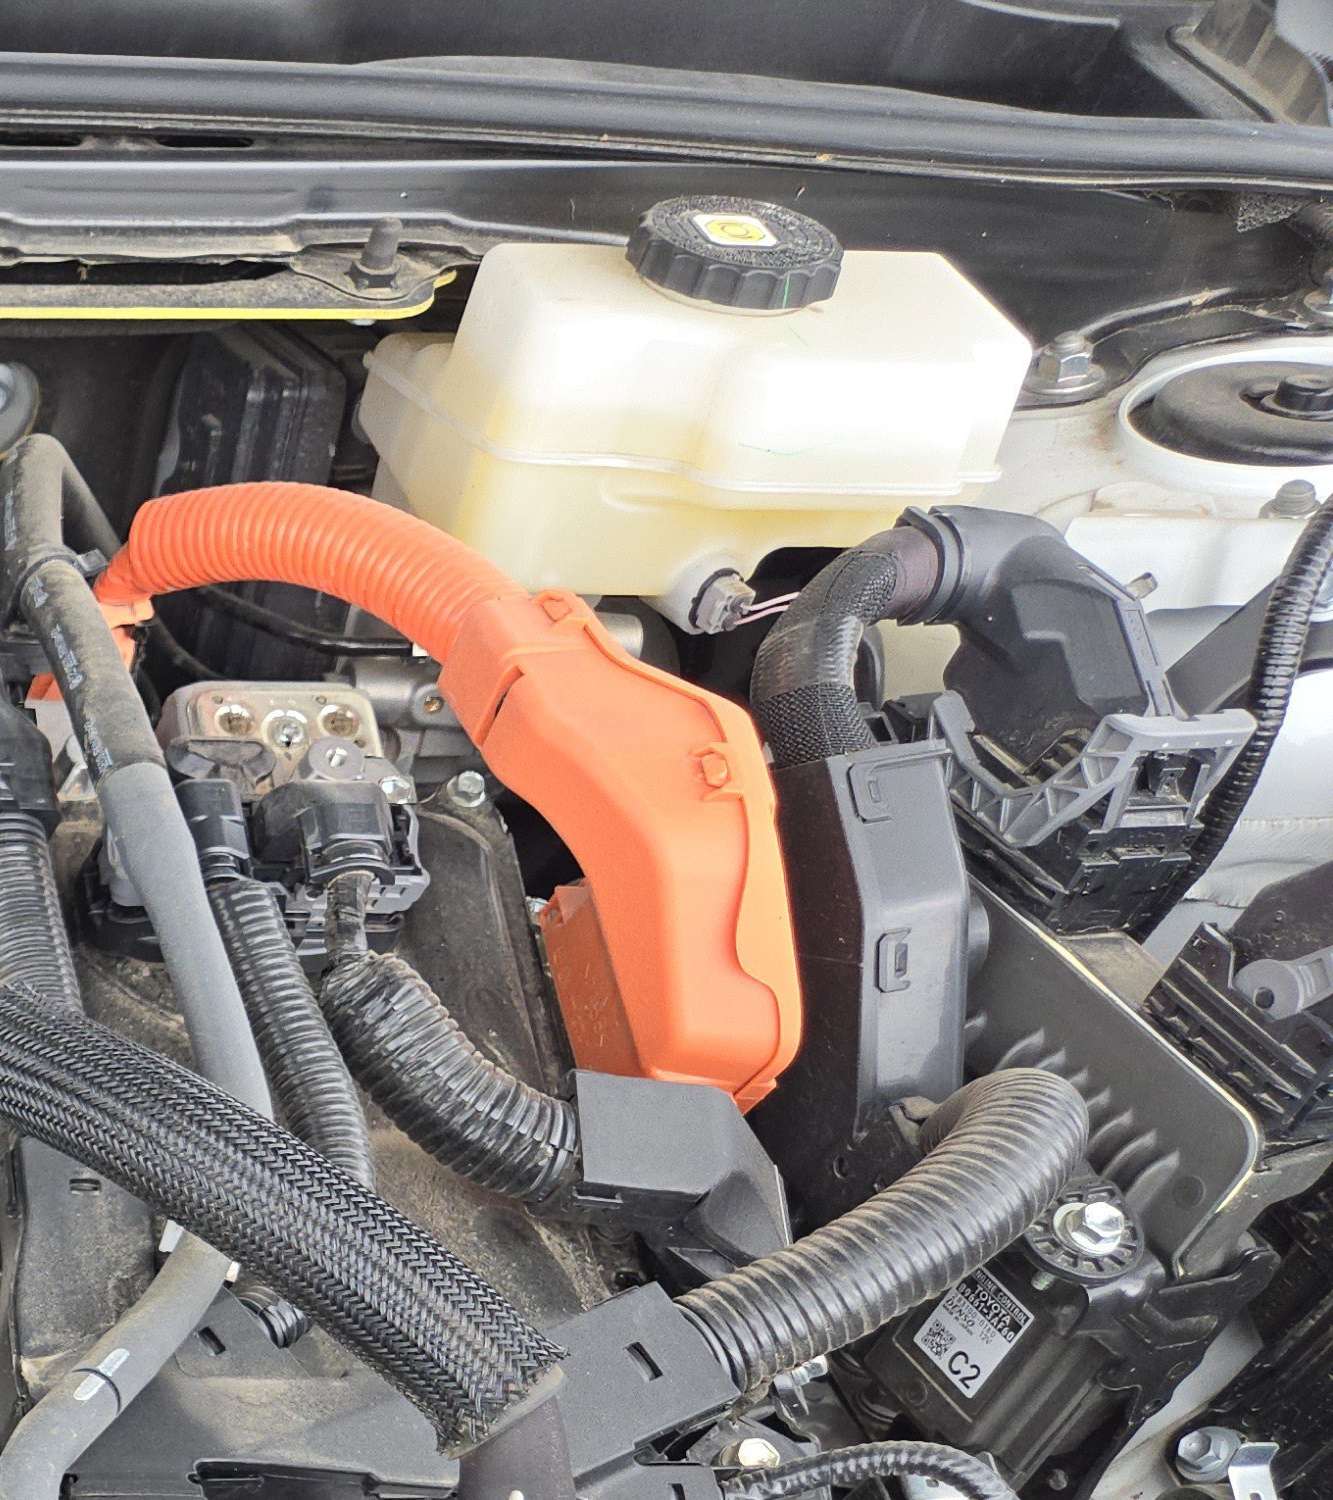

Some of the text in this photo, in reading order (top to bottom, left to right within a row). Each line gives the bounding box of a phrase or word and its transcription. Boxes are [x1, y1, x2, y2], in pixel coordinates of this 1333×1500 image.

[971, 1284, 1013, 1325] TOYOTA
[973, 1268, 1027, 1323] NGINE CONTROL
[945, 1297, 992, 1345] DENSO 12V
[948, 1351, 980, 1389] C2
